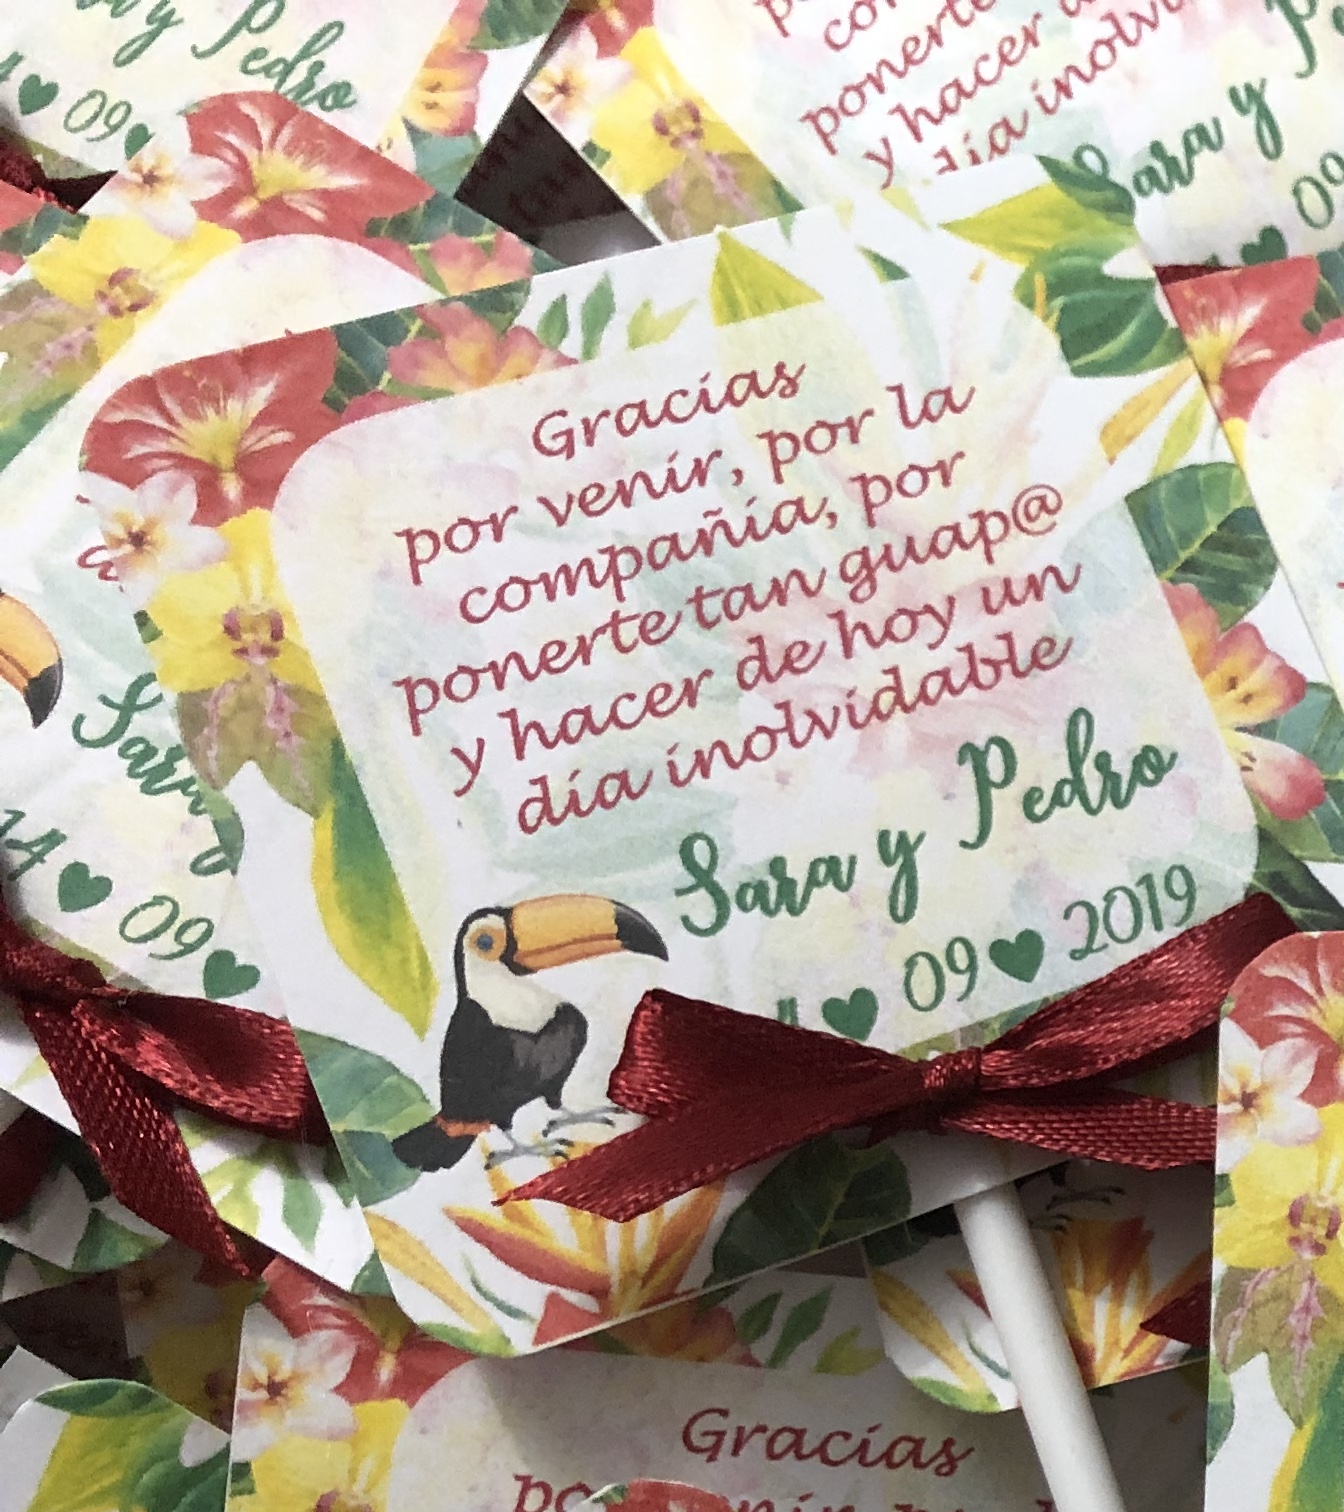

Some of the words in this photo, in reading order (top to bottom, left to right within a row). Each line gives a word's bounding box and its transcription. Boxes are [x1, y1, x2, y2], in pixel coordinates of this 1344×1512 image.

[62, 88, 133, 143] 09
[888, 13, 1041, 143] hacer
[1228, 83, 1280, 161] y
[532, 361, 806, 460] Gracias
[393, 505, 519, 586] por
[536, 450, 743, 527] venir,
[756, 408, 874, 484] por
[886, 384, 975, 429] la
[849, 451, 965, 528] por
[393, 610, 682, 736] ponerte
[688, 569, 826, 630] tan
[839, 484, 1063, 604] guap@
[667, 631, 1072, 788] inolvidable
[678, 832, 855, 936] Sara
[878, 831, 922, 921] y
[960, 709, 1176, 848] Pedro
[901, 937, 979, 1014] 09
[1062, 863, 1195, 954] 2019
[682, 1408, 975, 1477] Gracias
